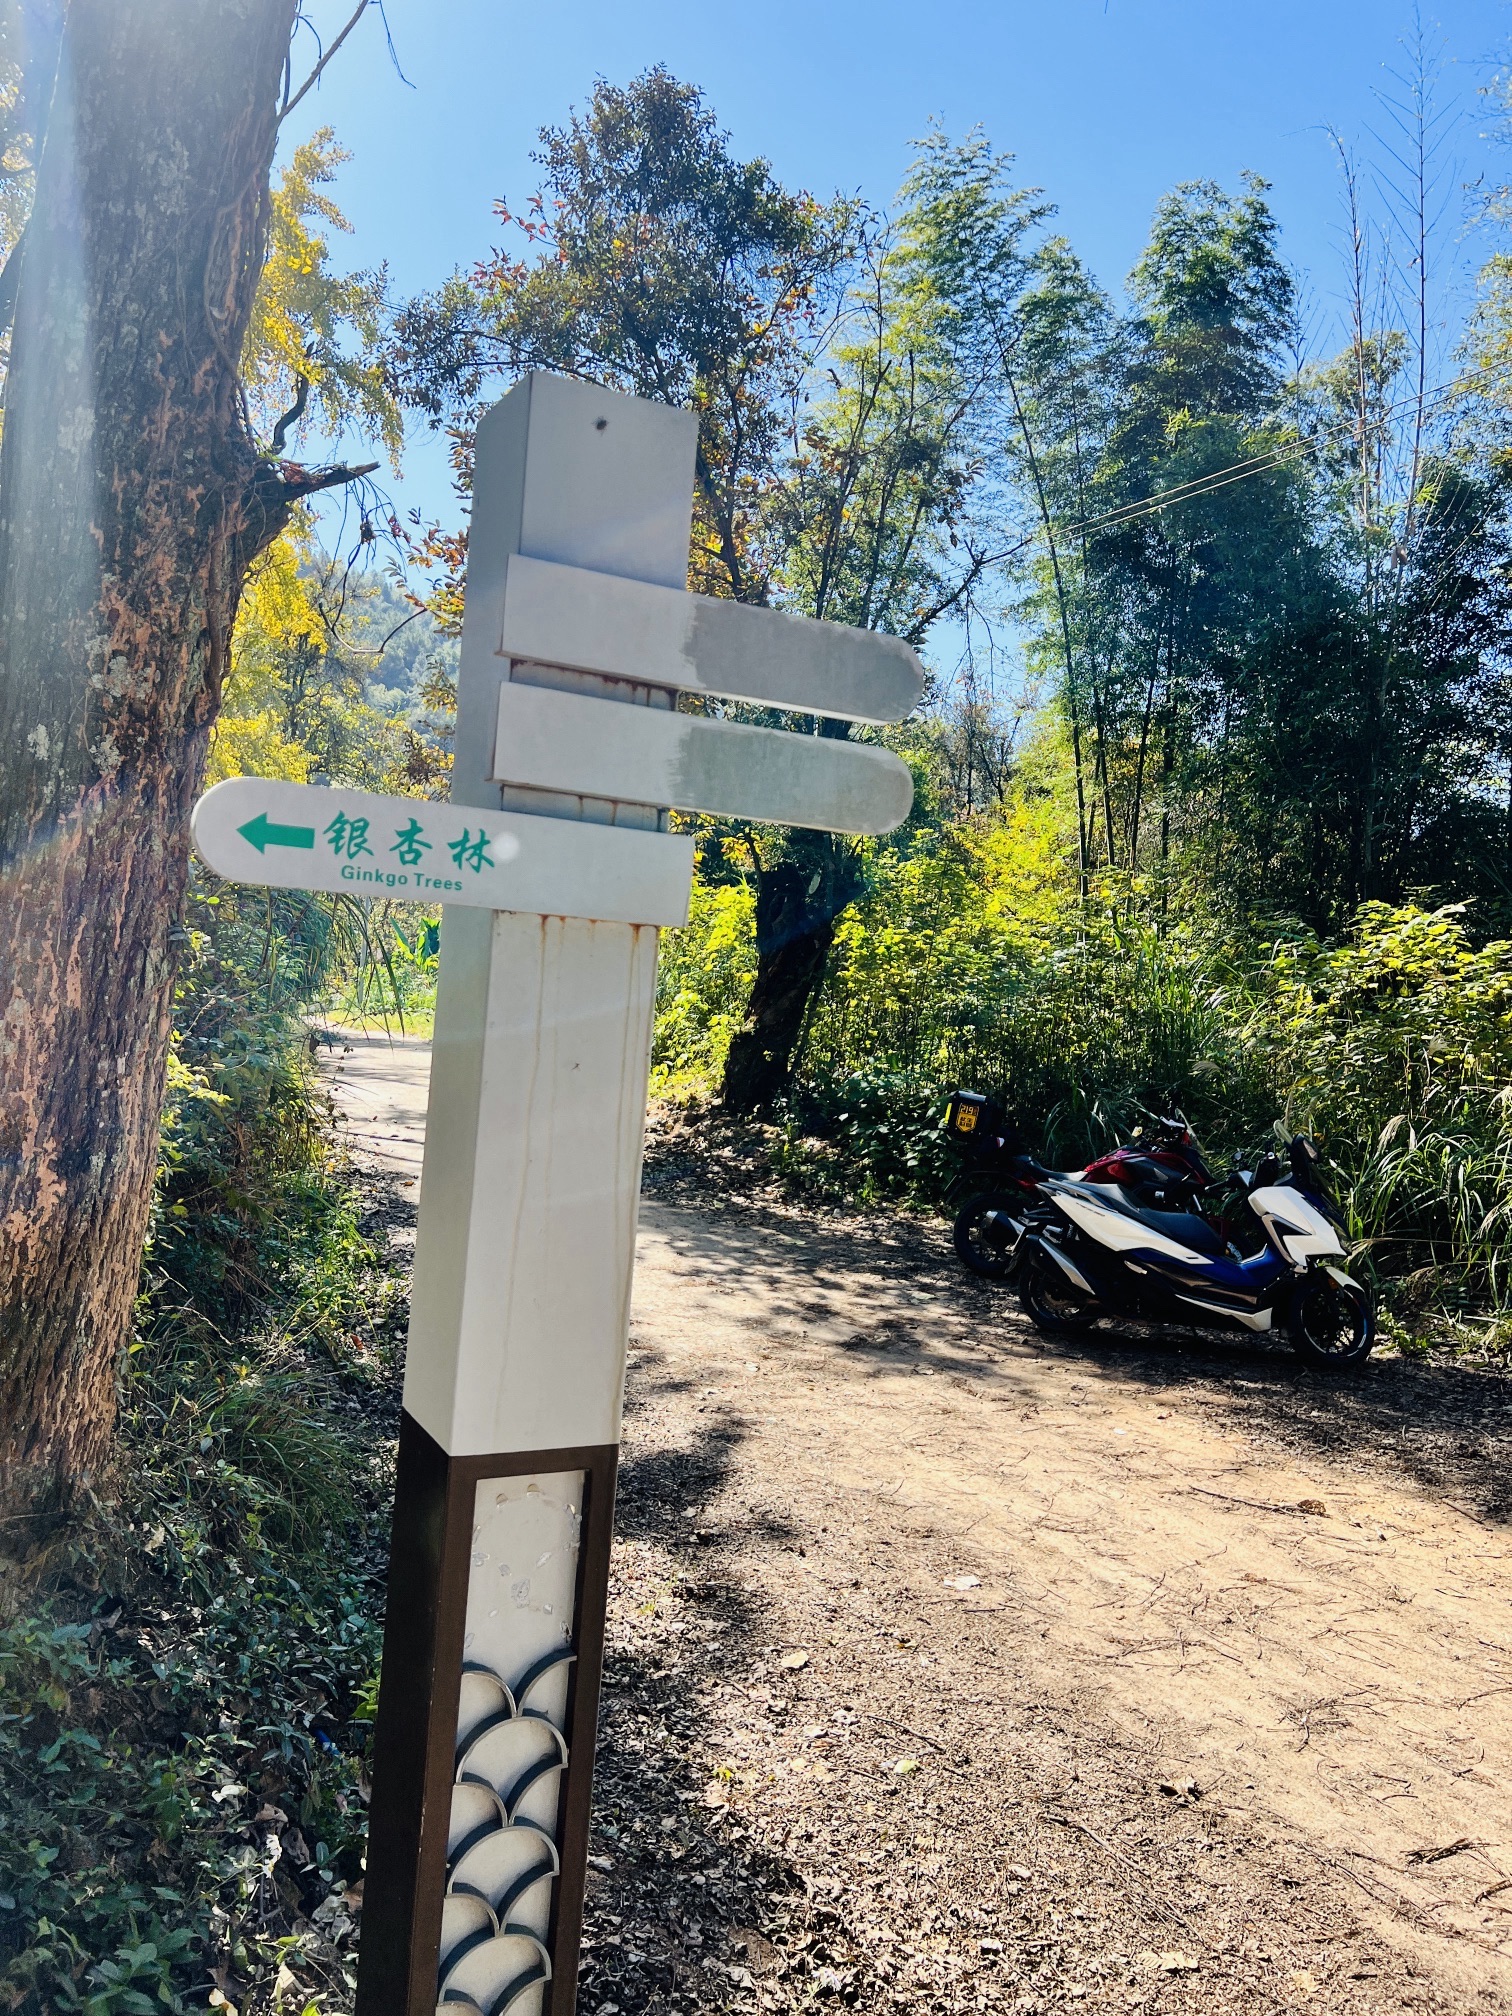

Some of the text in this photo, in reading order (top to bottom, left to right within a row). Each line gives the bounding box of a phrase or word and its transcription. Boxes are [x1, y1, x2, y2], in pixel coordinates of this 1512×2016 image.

[323, 810, 495, 874] 银杏林
[341, 865, 463, 891] Ginkgo Trees
